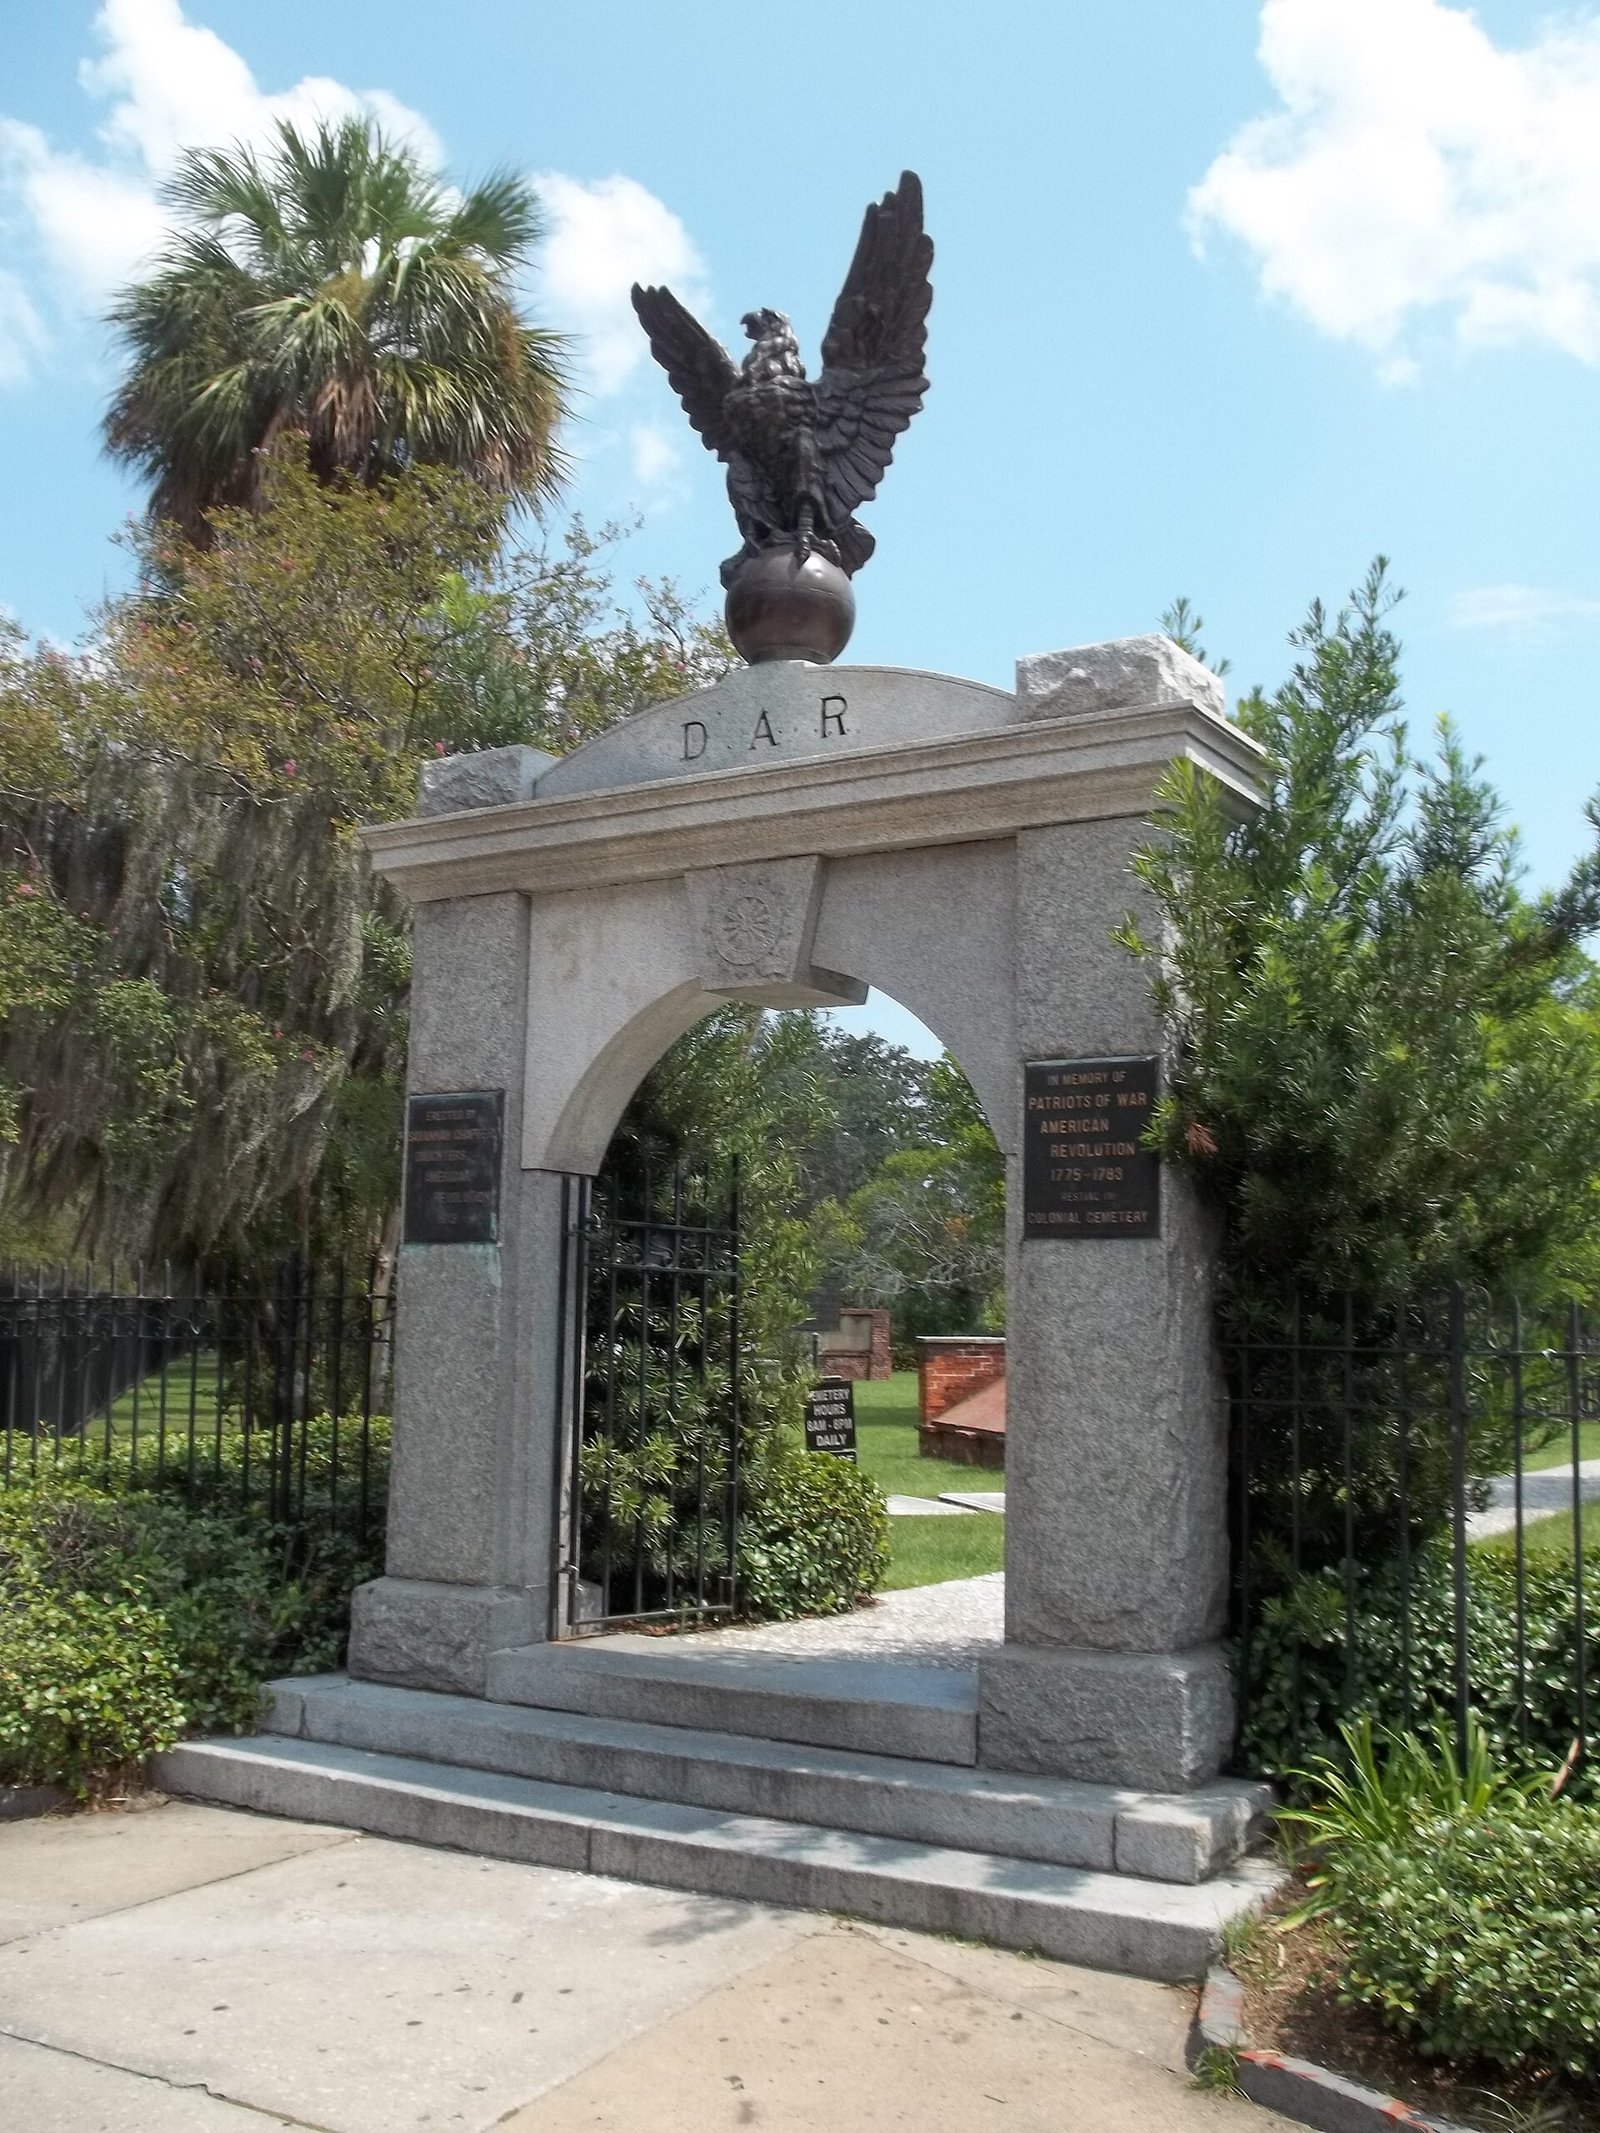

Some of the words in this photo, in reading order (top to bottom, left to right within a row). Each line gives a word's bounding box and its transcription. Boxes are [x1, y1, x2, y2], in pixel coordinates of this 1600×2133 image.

[1047, 1074, 1059, 1086] IN
[1061, 1072, 1109, 1085] MEMORY
[1112, 1070, 1127, 1083] OF
[1028, 1095, 1092, 1110] PATRIOTS
[1094, 1094, 1111, 1108] OF
[1117, 1092, 1148, 1106] WAR
[1040, 1119, 1110, 1134] AMERICAN
[1050, 1143, 1135, 1158] REVOLUTION
[1026, 1212, 1080, 1224] COLONIAL
[1086, 1211, 1148, 1224] CEMETERY
[808, 1389, 850, 1401] EMETERY
[813, 1404, 847, 1416] HOURS
[815, 1434, 847, 1447] DAILY
